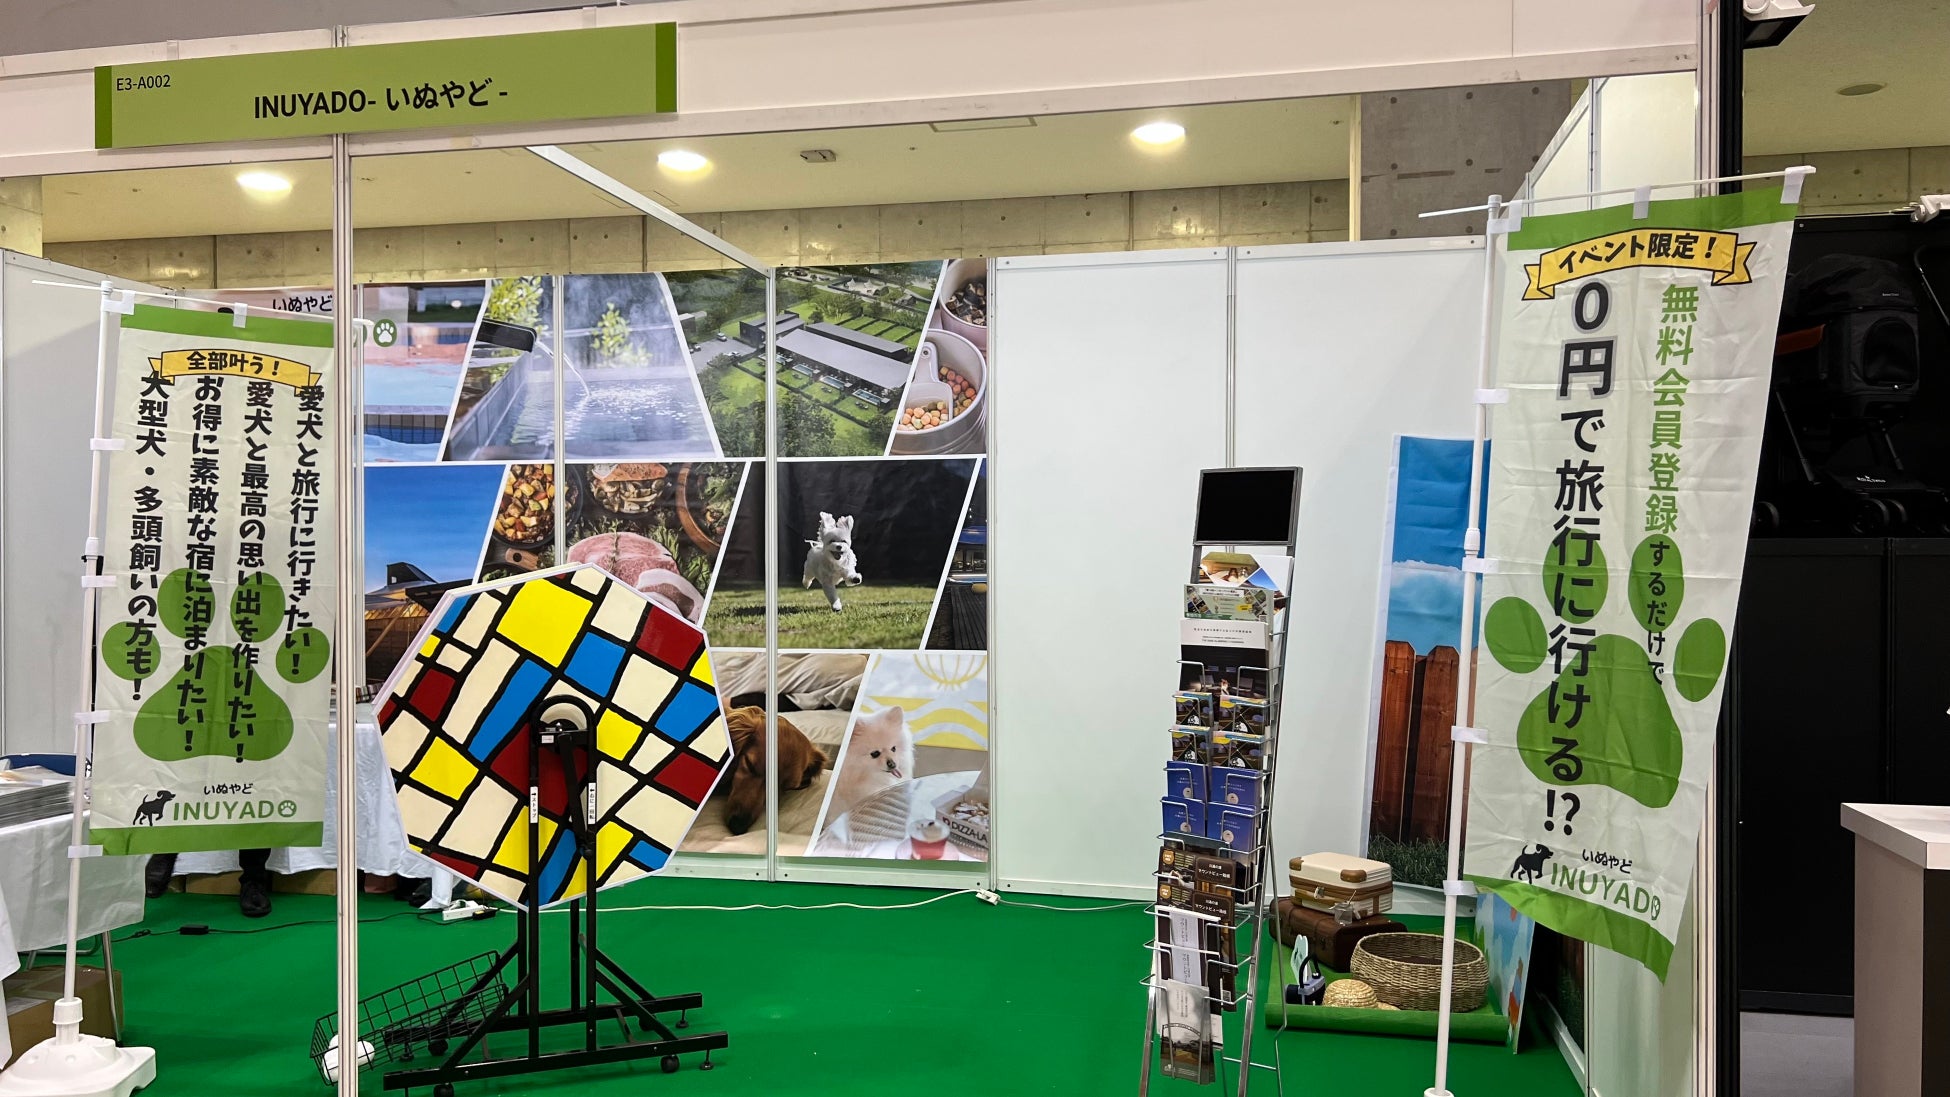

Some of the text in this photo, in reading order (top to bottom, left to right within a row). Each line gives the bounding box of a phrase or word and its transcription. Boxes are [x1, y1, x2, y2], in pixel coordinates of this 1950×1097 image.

[116, 74, 171, 92] E3-A002
[386, 77, 493, 111] いぬやど
[1558, 233, 1717, 273] イベント限定！
[186, 352, 280, 376] 全部叶う！
[284, 385, 325, 676] 愛犬と旅行に行きたい！
[177, 375, 224, 752] お得に素敵な宿に泊まりたい！
[228, 382, 275, 763] 愛犬と最高の思い出を作りたい！
[203, 783, 254, 796] いぬやど
[1582, 849, 1633, 874] いぬやど
